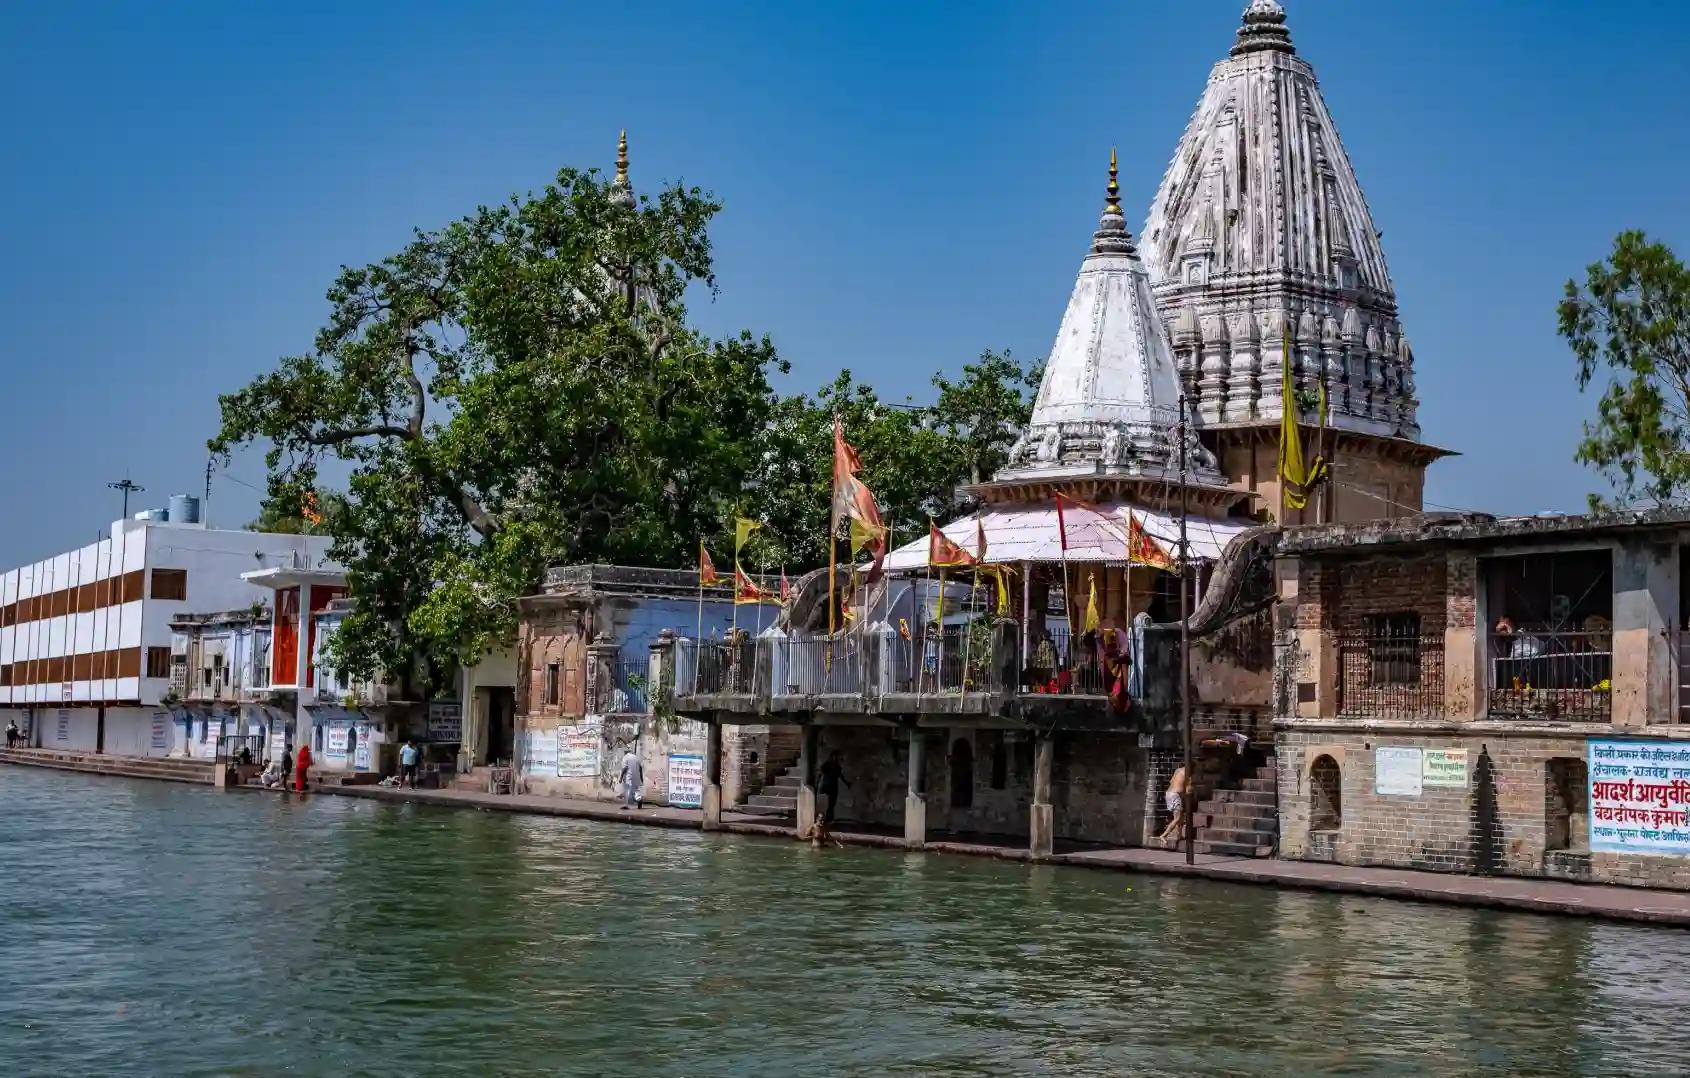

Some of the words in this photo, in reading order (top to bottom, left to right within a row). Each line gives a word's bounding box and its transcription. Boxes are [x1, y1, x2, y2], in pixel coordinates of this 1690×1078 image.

[1592, 778, 1634, 801] आदर्श
[1594, 802, 1613, 821] वैद्य
[1614, 803, 1649, 823] दीपक
[1651, 808, 1686, 829] कुमार
